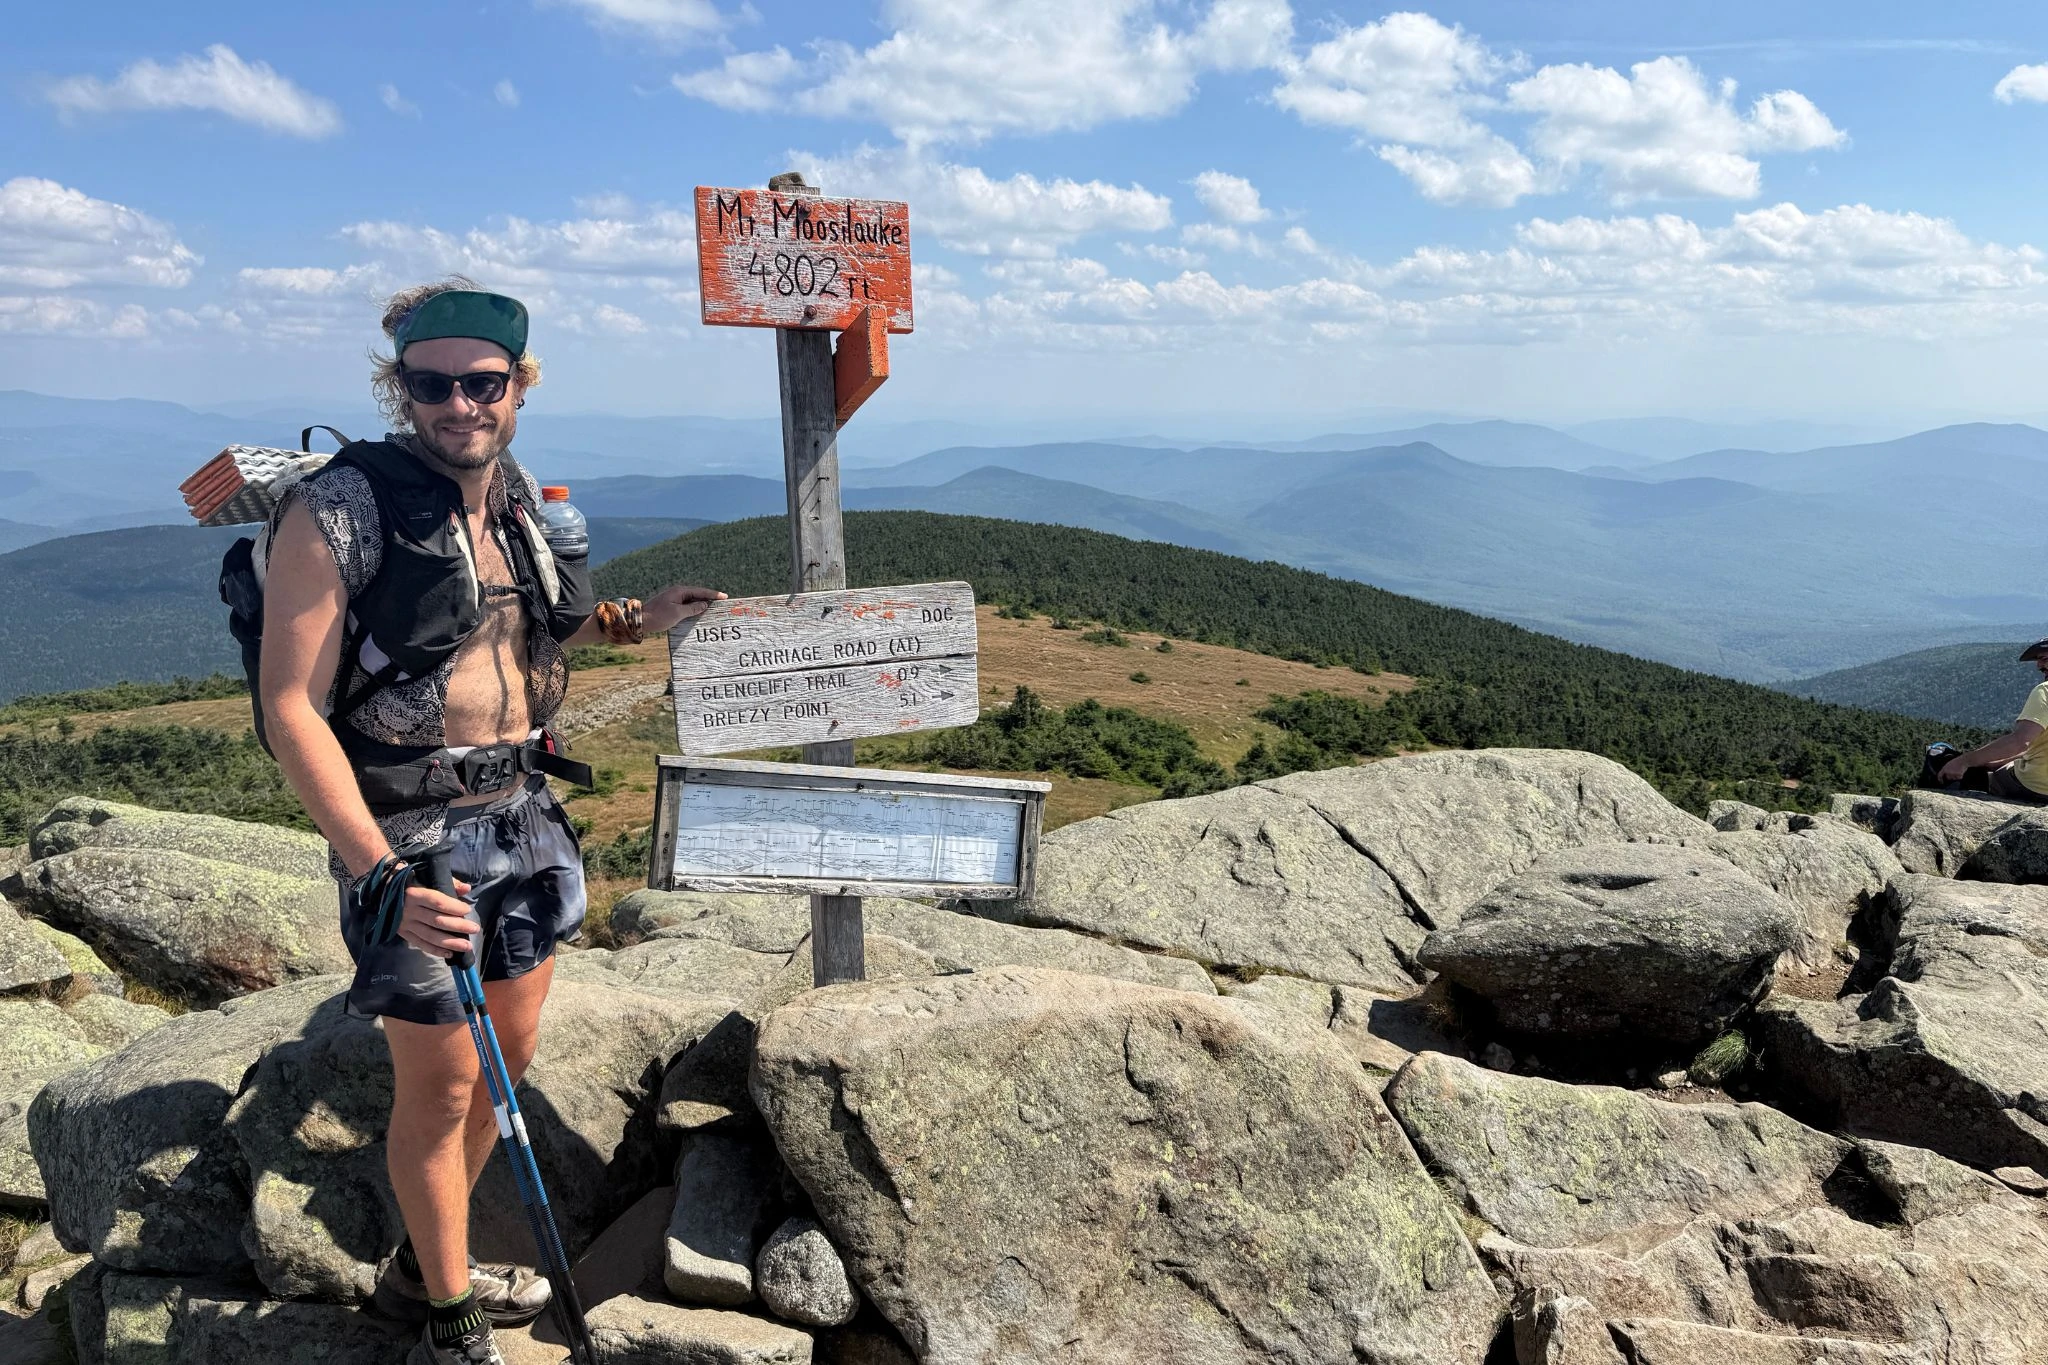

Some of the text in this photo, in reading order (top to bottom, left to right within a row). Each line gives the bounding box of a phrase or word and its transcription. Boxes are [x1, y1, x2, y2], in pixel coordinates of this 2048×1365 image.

[773, 198, 902, 247] Moosilauke
[749, 252, 839, 298] 4802
[922, 607, 953, 623] DOC
[739, 637, 921, 668] CARRIAGE ROAD (AT)
[701, 678, 792, 700] GLENCLIFF
[805, 672, 851, 691] TRAIL
[703, 707, 770, 728] BREEZY
[784, 701, 830, 720] POINT
